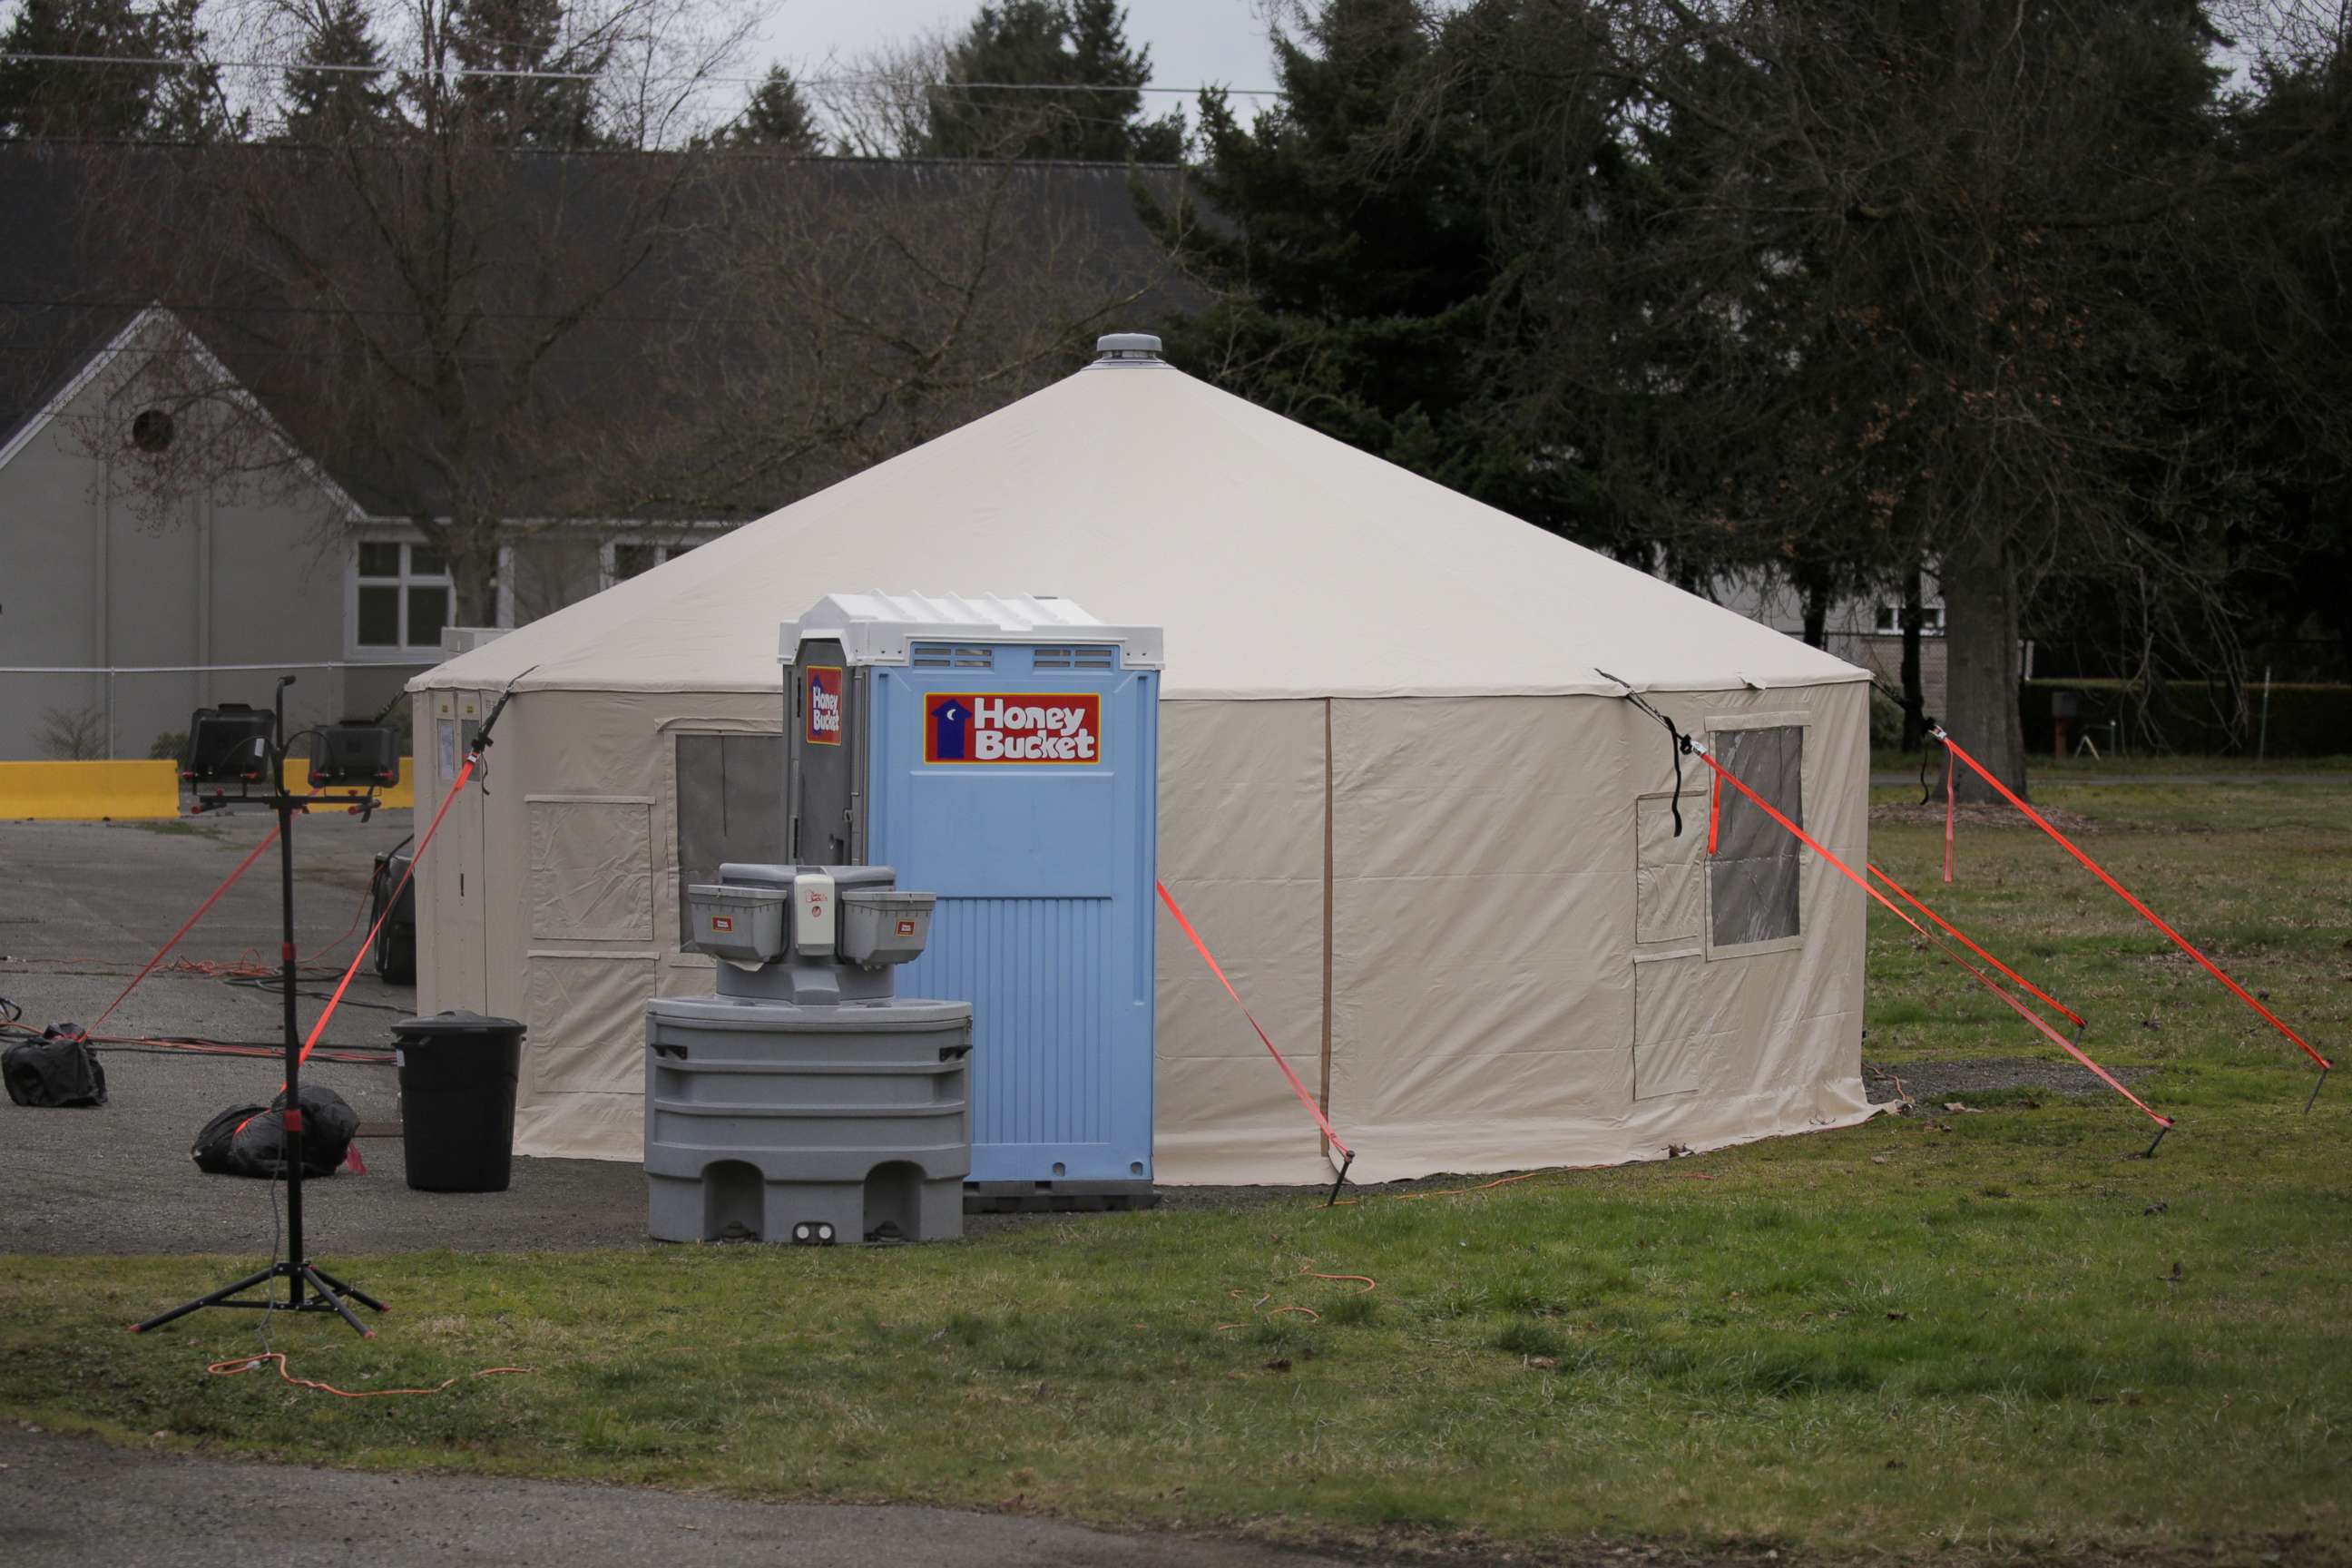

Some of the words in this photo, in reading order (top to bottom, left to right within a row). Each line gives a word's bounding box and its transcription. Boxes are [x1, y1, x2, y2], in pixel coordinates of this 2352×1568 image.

[812, 686, 838, 711] Honey
[813, 709, 839, 731] Bucket
[974, 697, 1086, 737] Honey
[975, 728, 1095, 760] Bucket
